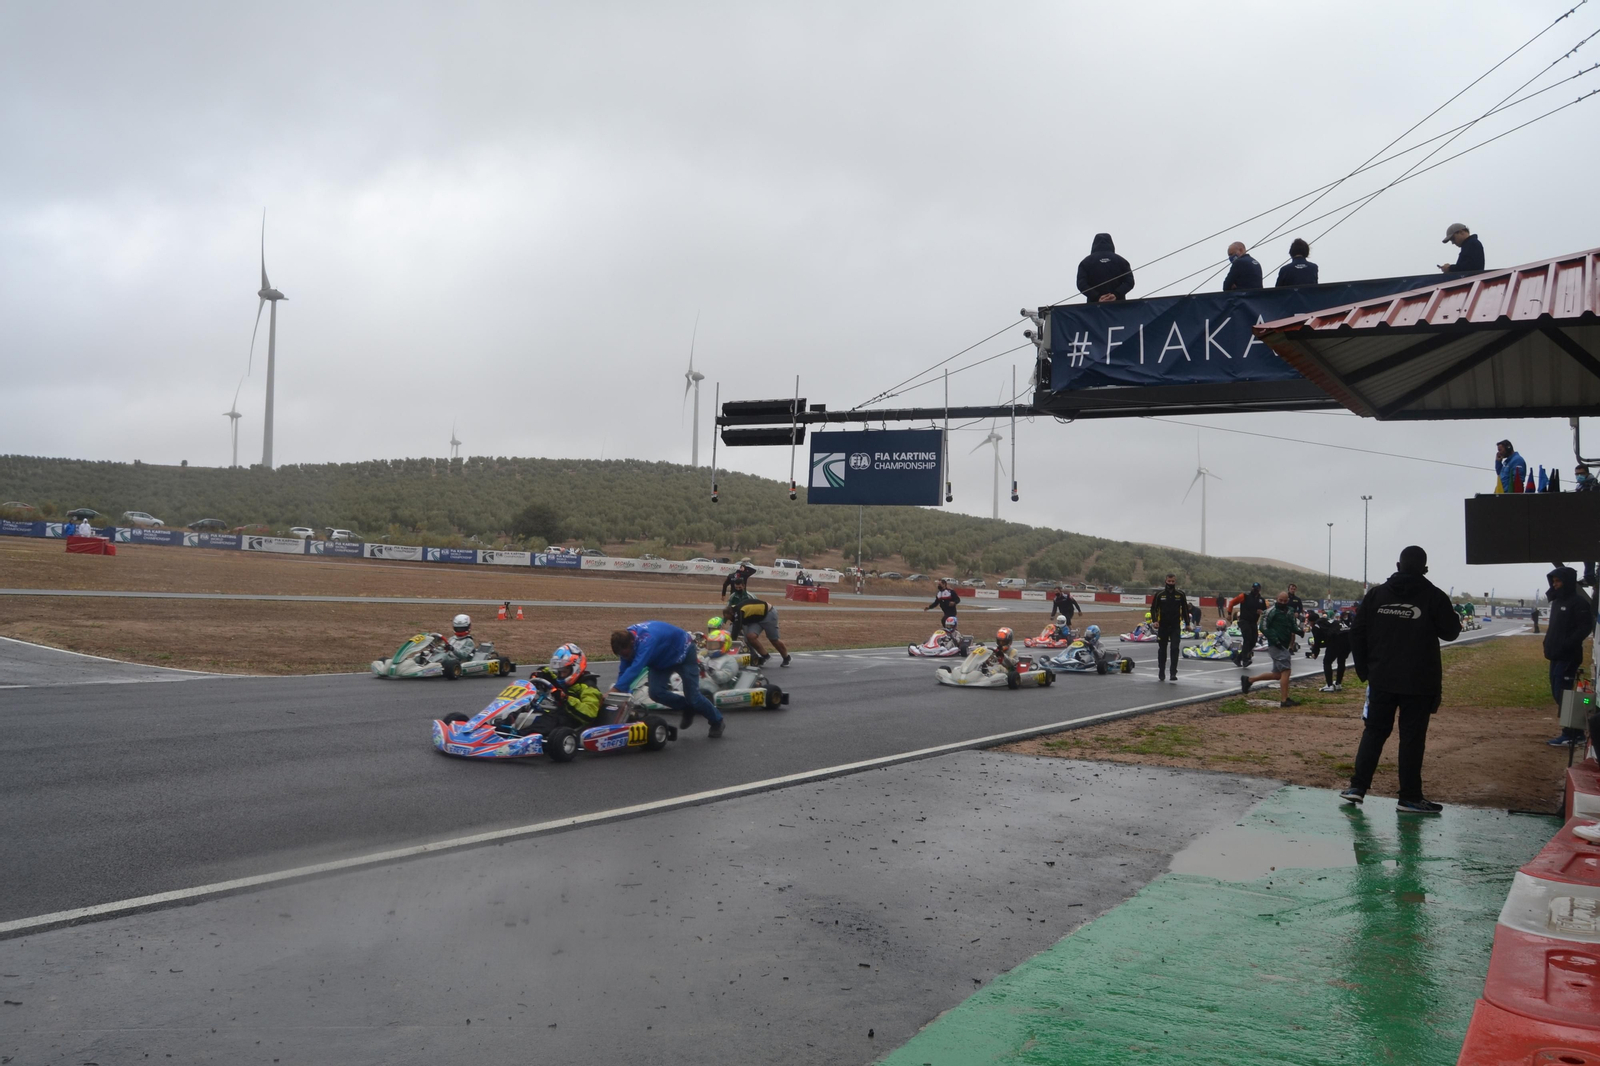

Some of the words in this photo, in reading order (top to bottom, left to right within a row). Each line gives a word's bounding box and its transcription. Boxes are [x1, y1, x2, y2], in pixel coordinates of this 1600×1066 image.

[1067, 313, 1306, 367] #FIAKA
[874, 453, 890, 462] FIA
[893, 452, 936, 462] KARTING
[874, 461, 936, 471] CHAMPIONSHIP
[1377, 608, 1412, 616] RGMMC
[498, 686, 528, 699] 111
[629, 725, 647, 745] 111
